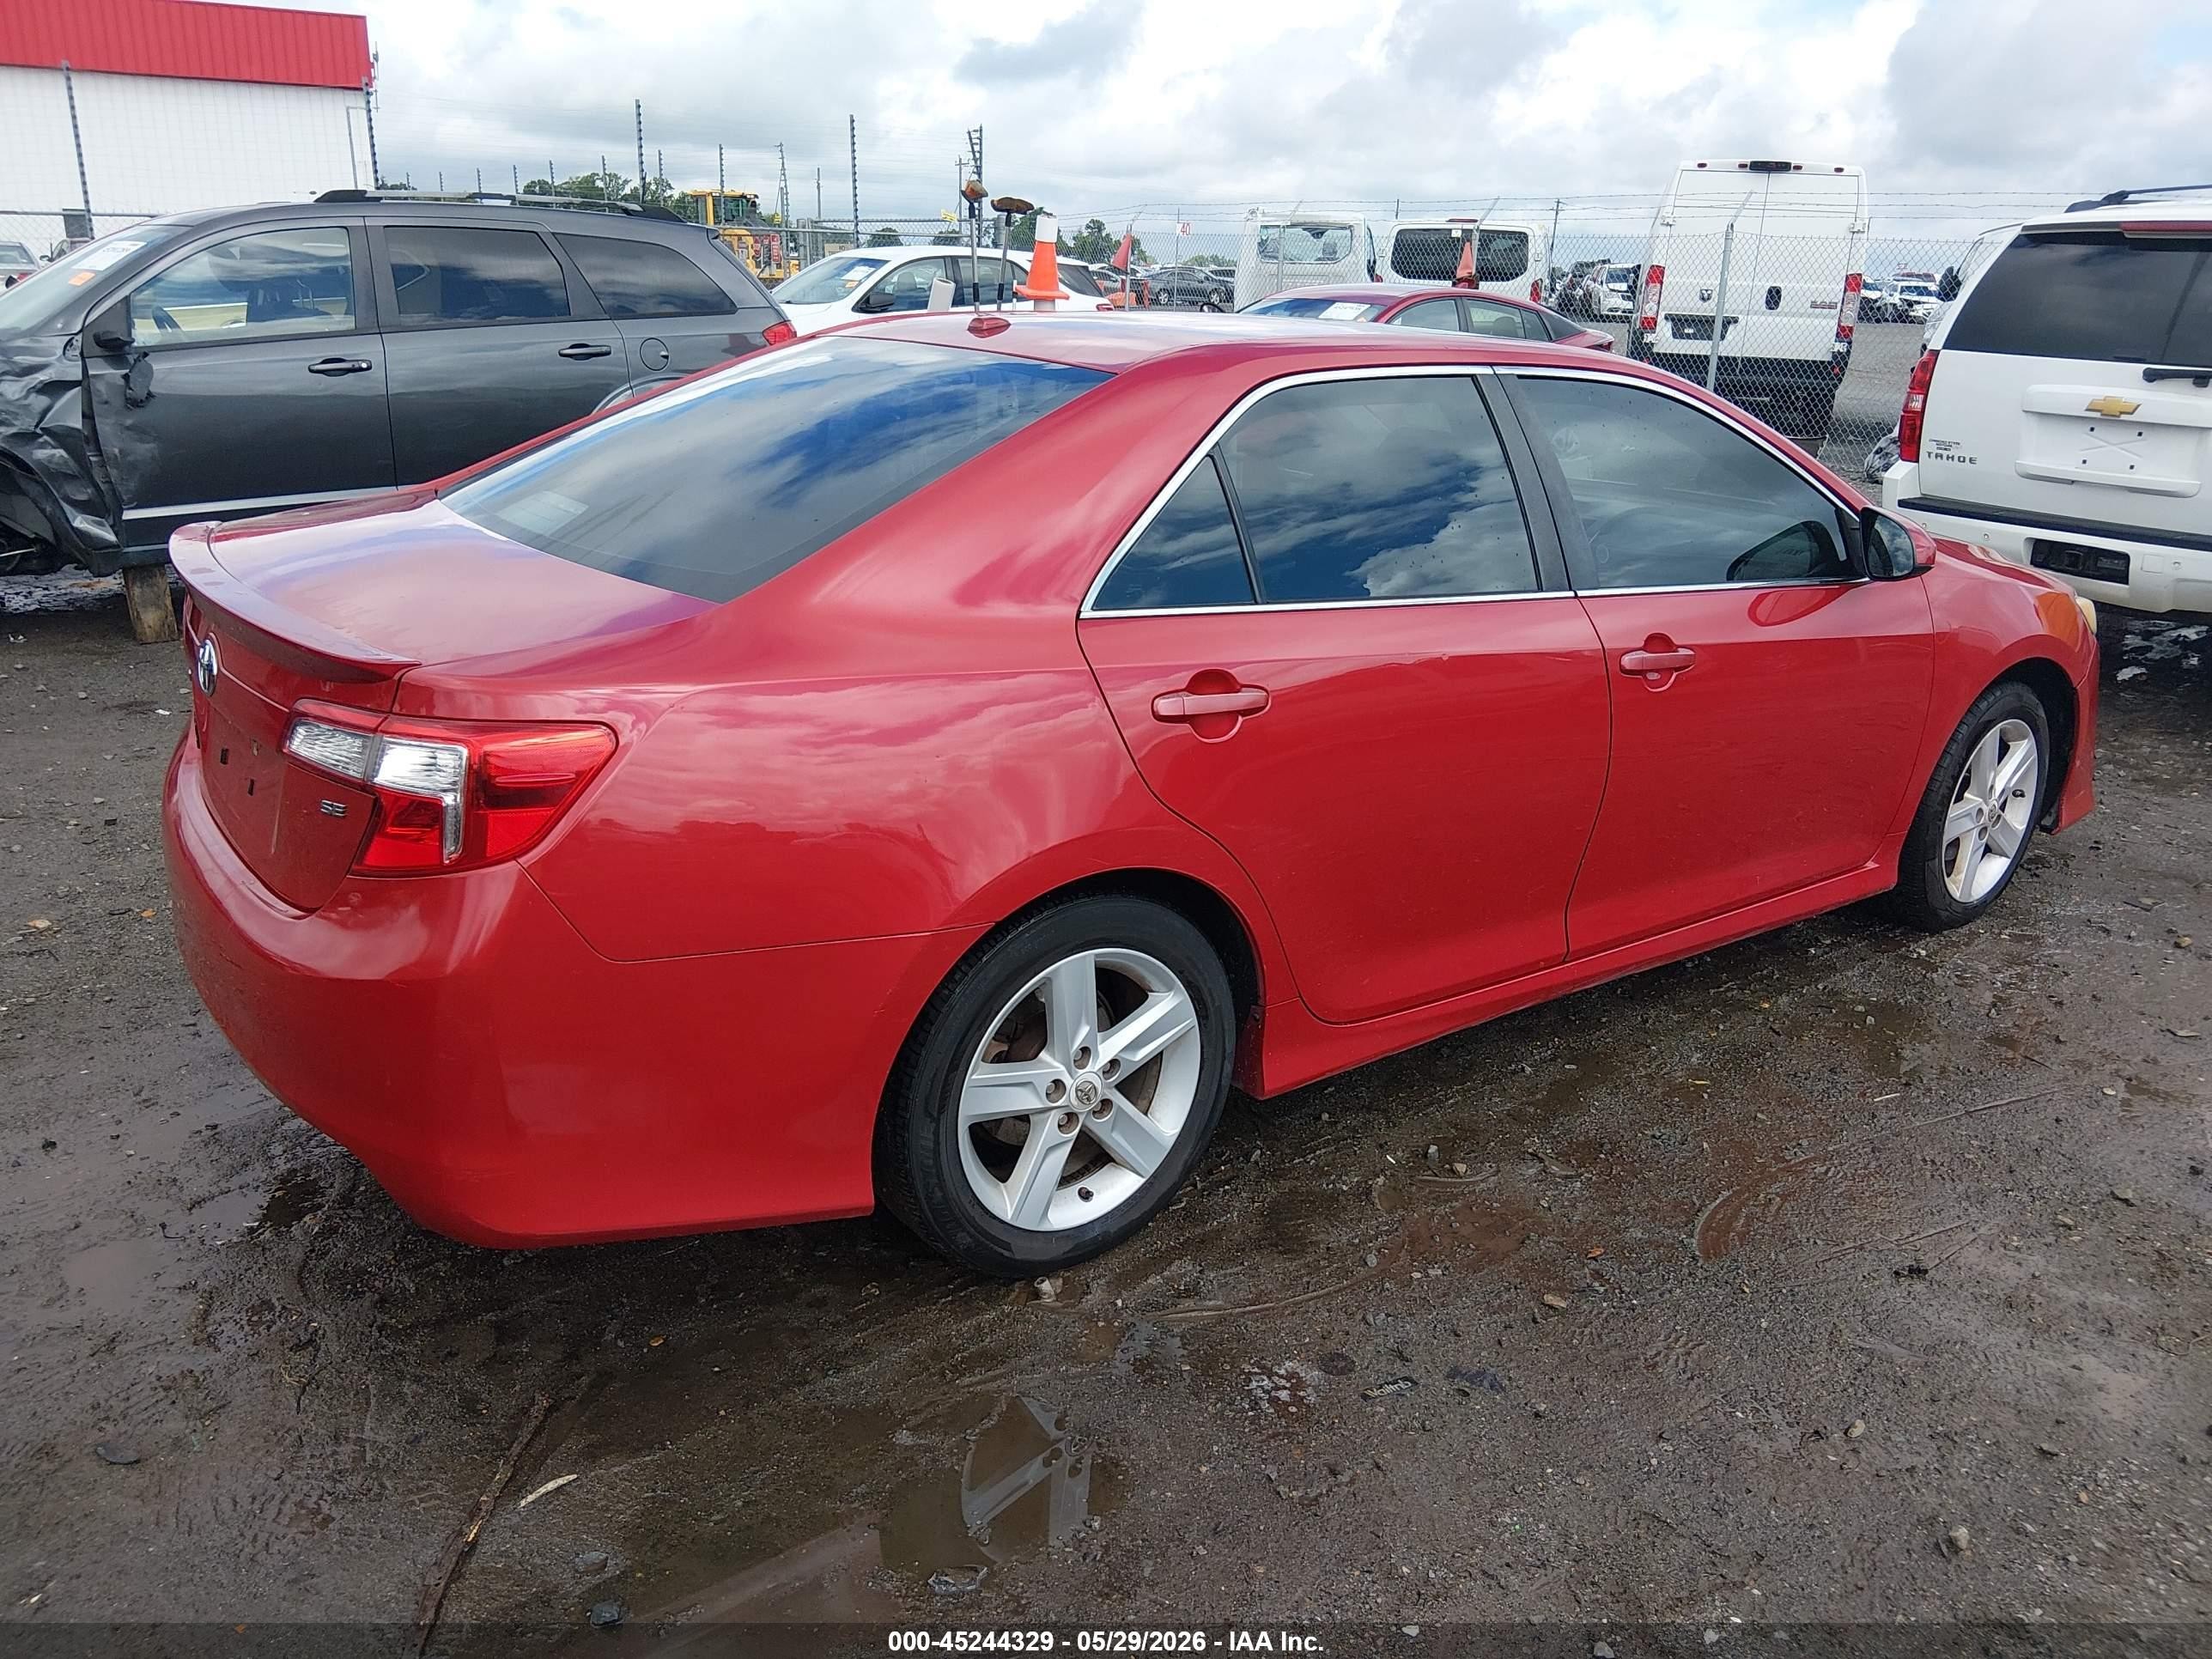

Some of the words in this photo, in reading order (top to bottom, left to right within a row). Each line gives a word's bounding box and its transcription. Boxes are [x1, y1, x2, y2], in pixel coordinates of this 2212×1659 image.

[1181, 222, 1190, 235] 40
[1926, 451, 1978, 465] TAHOE
[319, 799, 348, 818] SE
